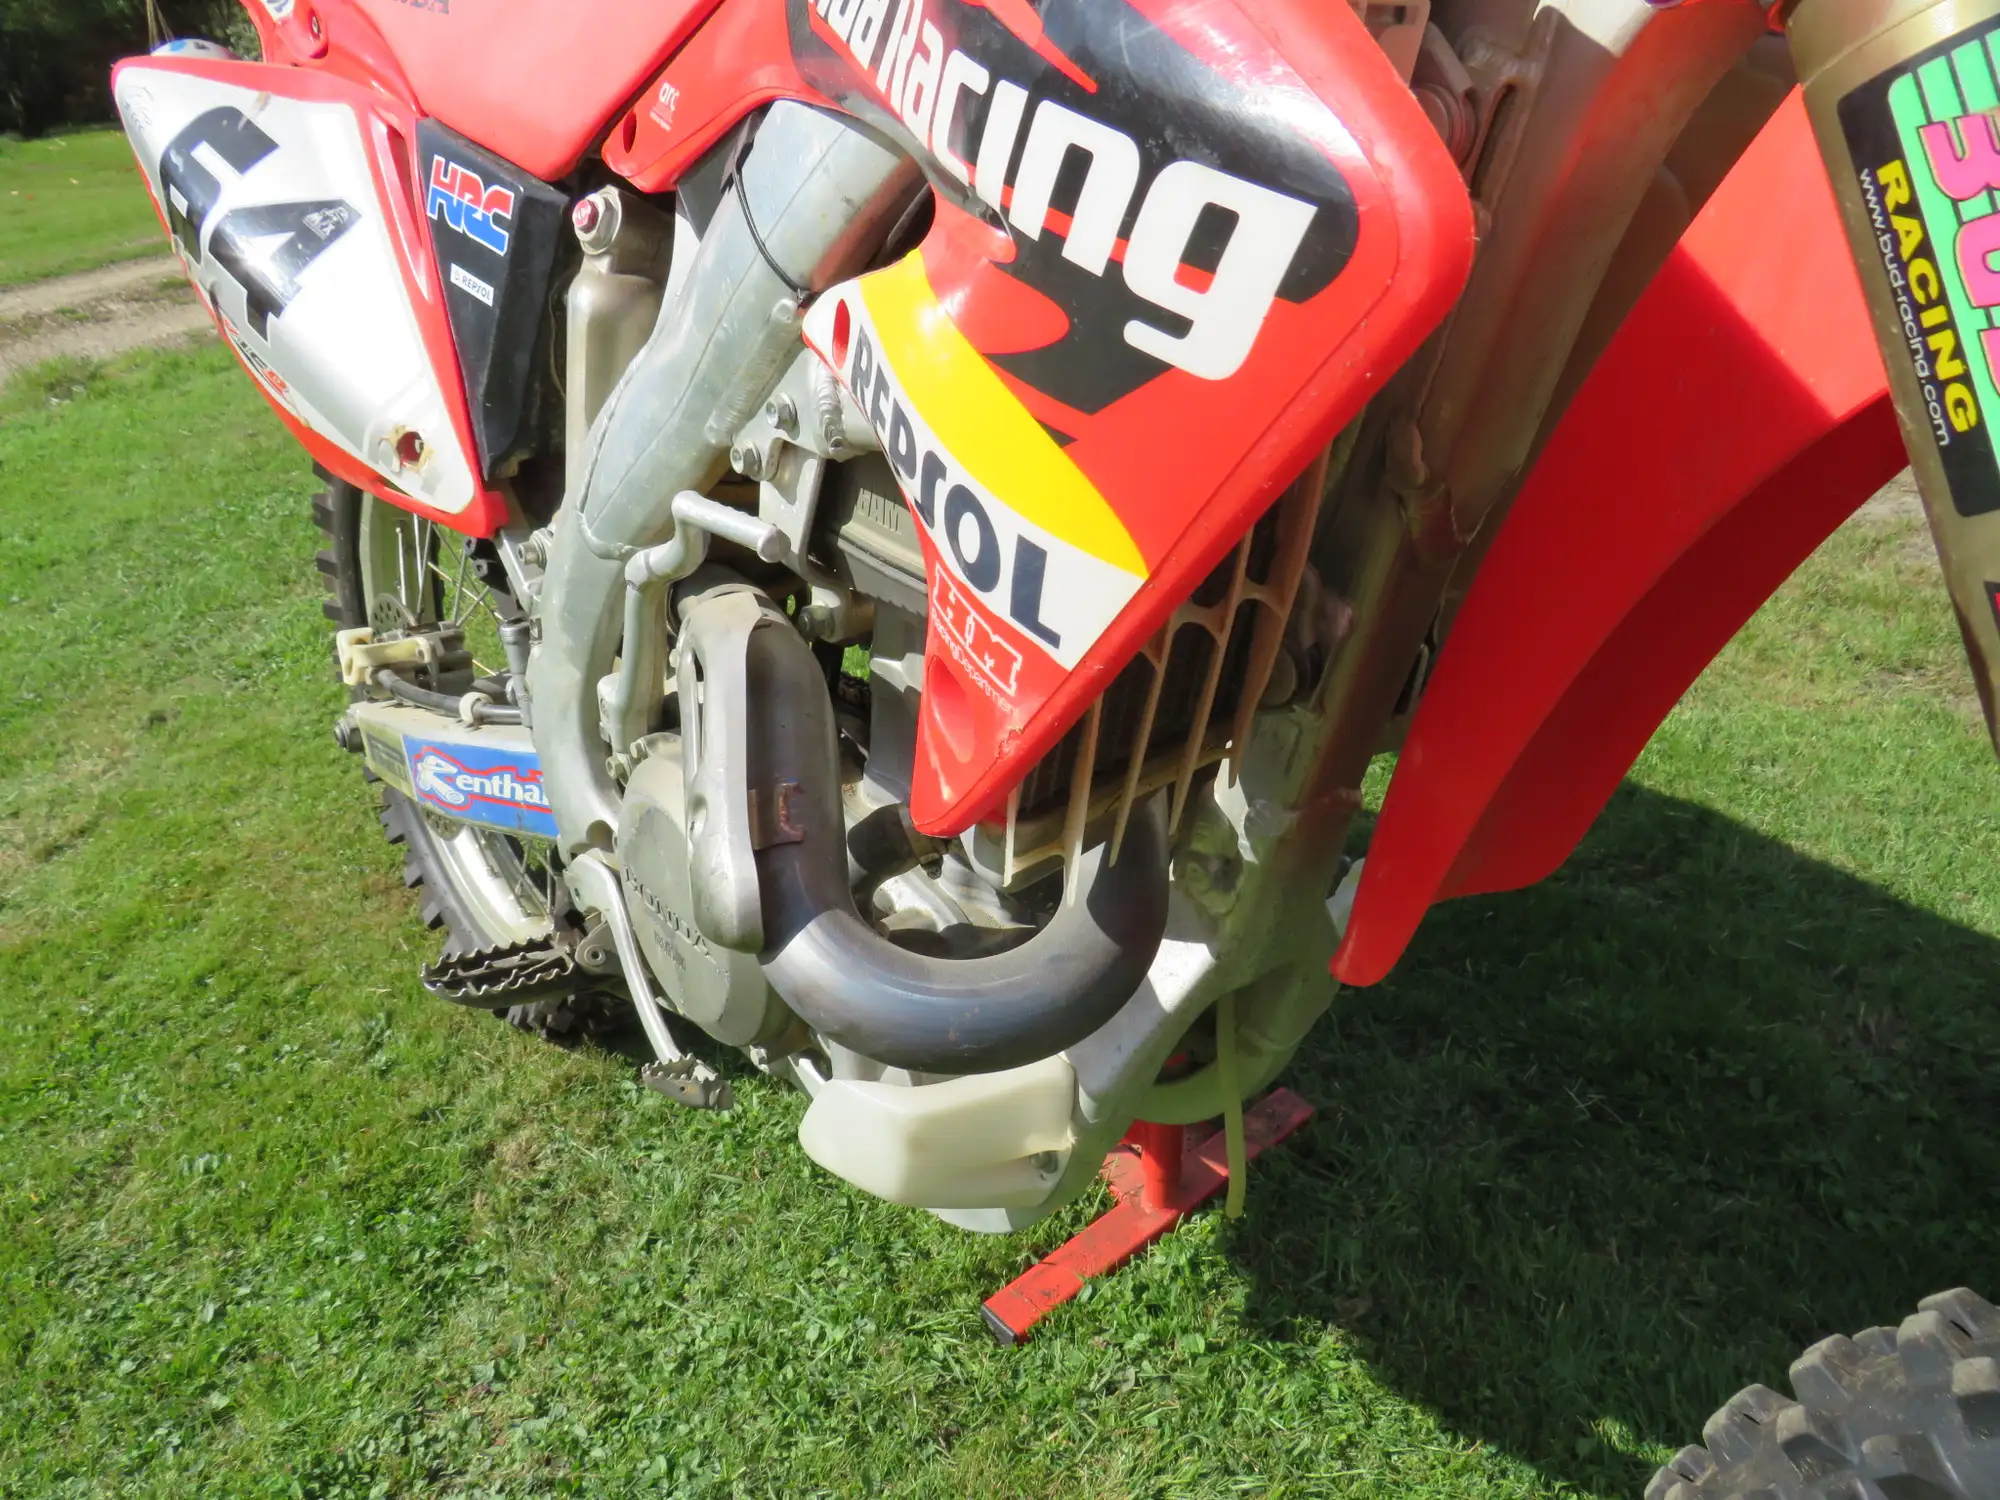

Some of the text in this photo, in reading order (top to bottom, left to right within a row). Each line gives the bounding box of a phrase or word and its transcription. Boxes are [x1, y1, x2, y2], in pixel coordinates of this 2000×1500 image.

[427, 154, 515, 257] HRC
[461, 274, 492, 302] REPSOL
[875, 0, 1318, 380] Racing
[1859, 168, 1950, 447] www.bud-racing.com
[1876, 159, 1978, 435] RACING
[850, 324, 1062, 650] REPSOL
